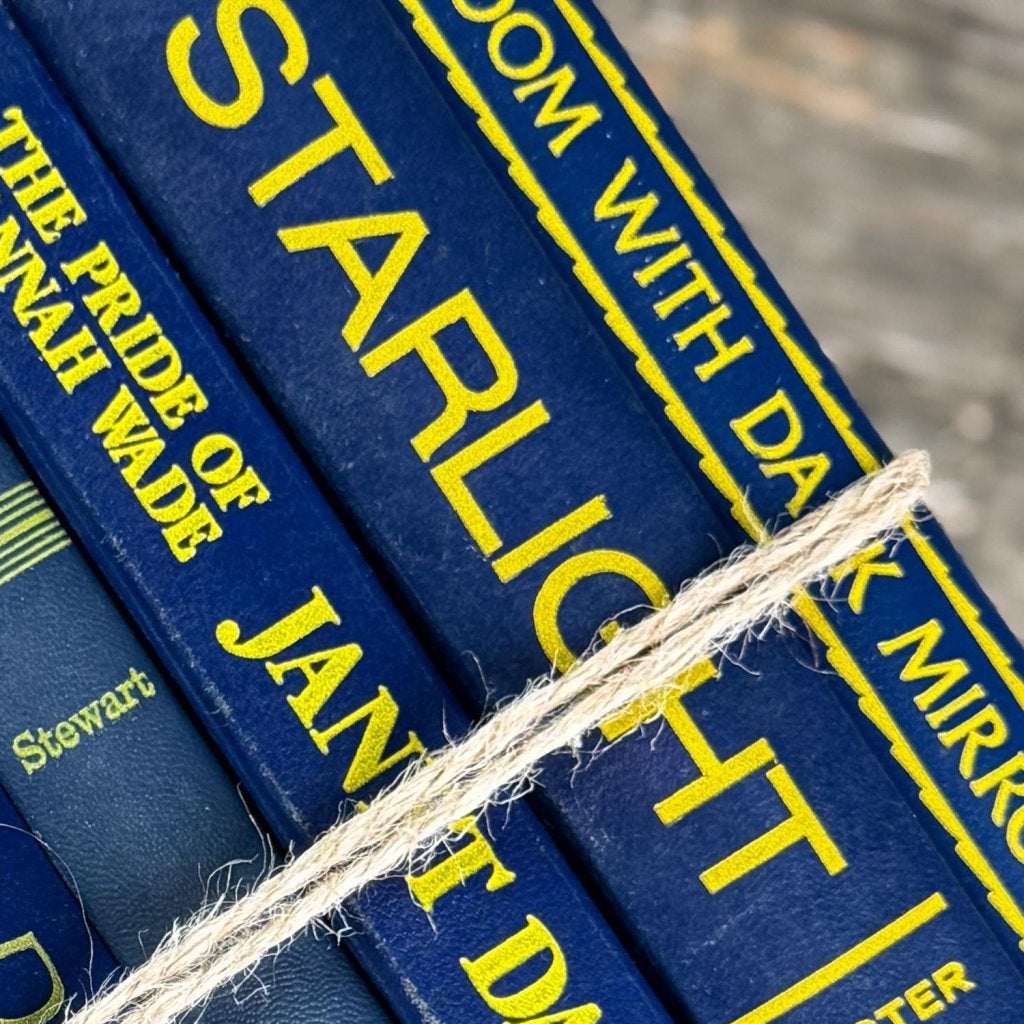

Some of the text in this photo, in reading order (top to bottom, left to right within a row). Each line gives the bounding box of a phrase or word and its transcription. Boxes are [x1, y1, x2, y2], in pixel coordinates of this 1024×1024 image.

[62, 243, 208, 430] PRIDE
[190, 433, 271, 512] OF
[92, 385, 223, 563] WADE
[165, 0, 847, 894] STARLIGHT
[593, 159, 754, 382] WITH
[728, 389, 904, 615] DAK
[876, 617, 1024, 865] MIRR
[12, 668, 158, 777] Stewart
[214, 585, 517, 914] JANT
